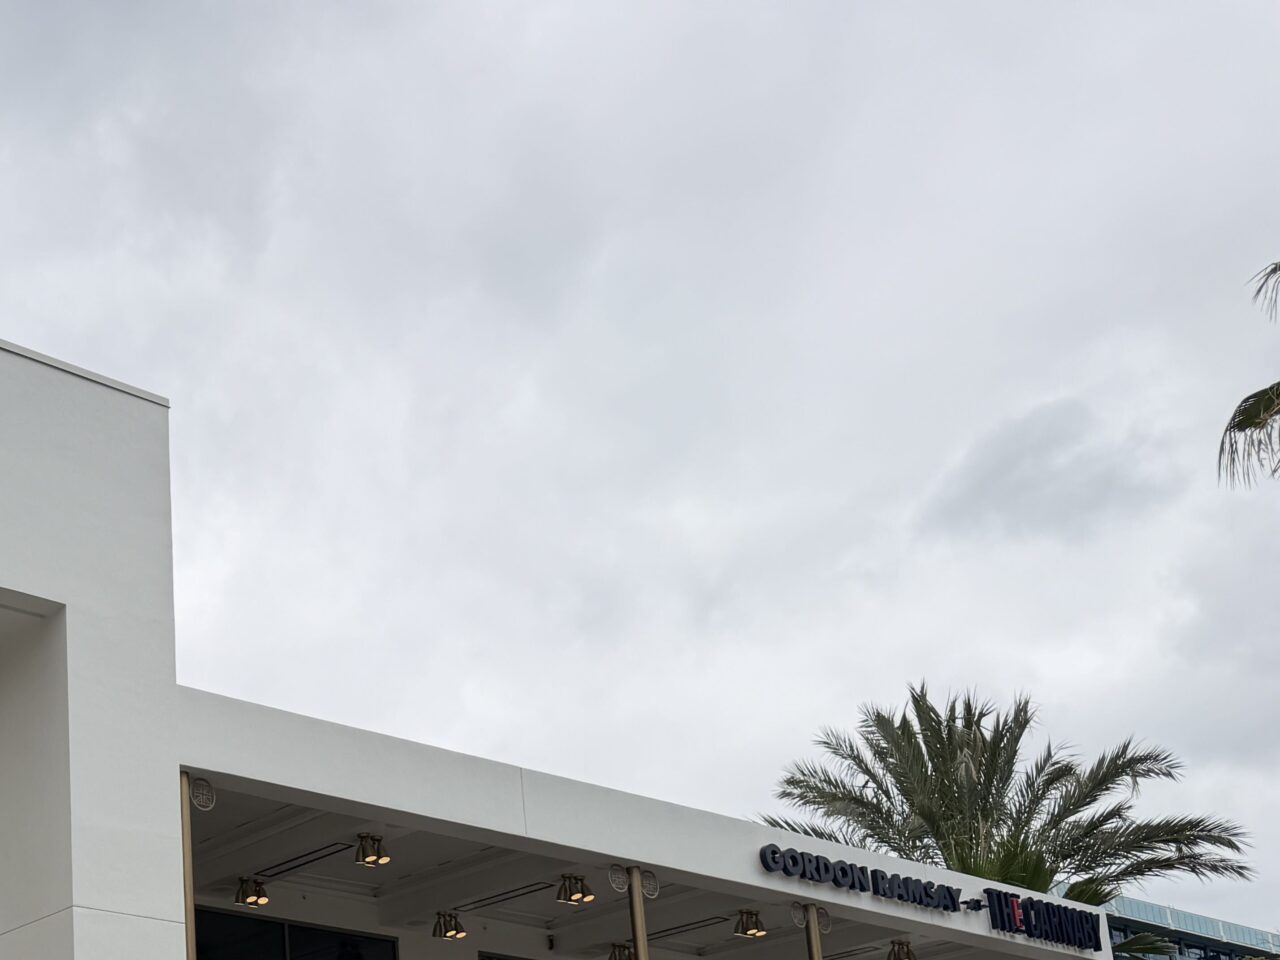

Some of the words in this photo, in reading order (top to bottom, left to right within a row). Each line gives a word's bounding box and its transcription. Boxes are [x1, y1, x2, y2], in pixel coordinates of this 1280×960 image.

[760, 843, 870, 892] GORDON
[871, 869, 962, 912] RAMSAY
[983, 888, 1026, 935] THE
[1021, 897, 1102, 951] CARNABY
